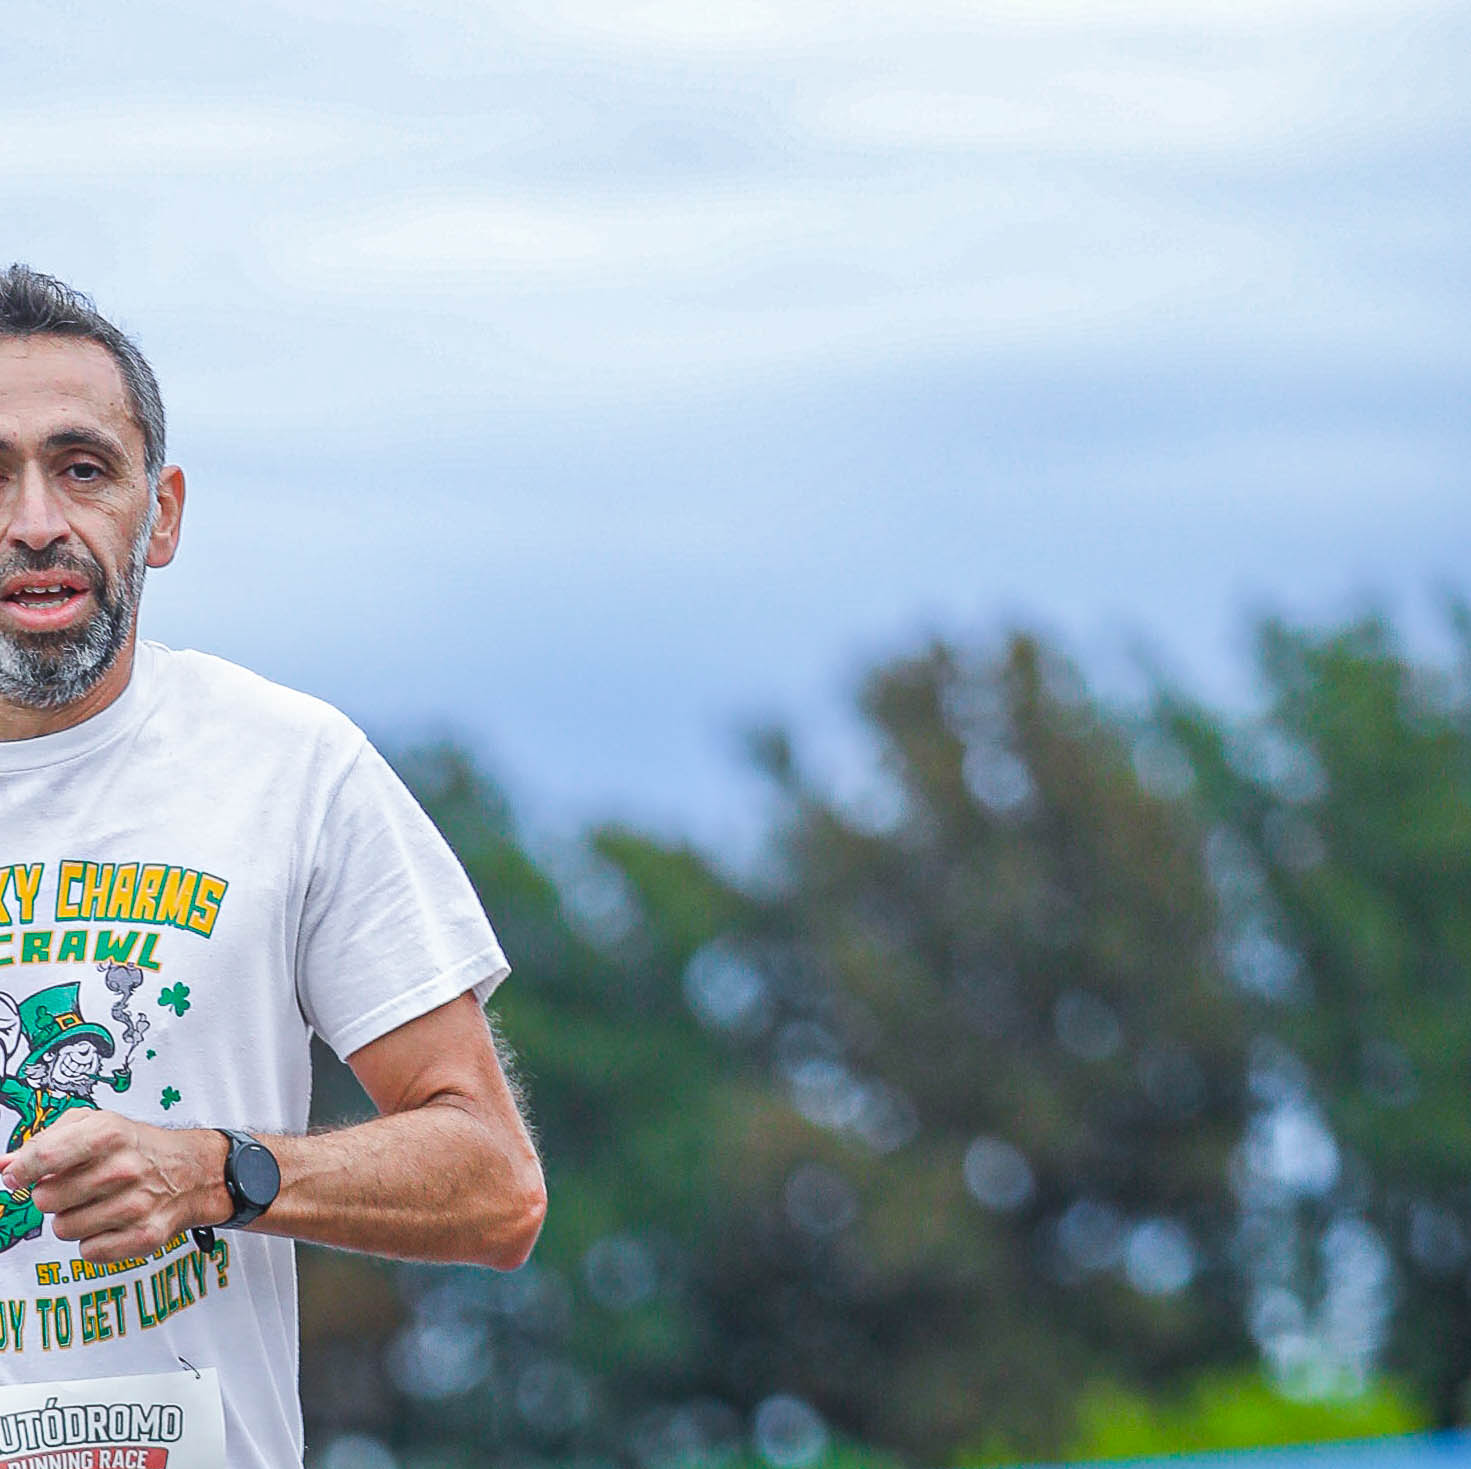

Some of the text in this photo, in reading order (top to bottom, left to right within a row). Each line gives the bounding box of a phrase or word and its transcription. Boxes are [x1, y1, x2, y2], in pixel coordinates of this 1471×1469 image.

[55, 860, 228, 939] CHARMS
[35, 1262, 69, 1285] ST.
[36, 1297, 73, 1351] TO
[79, 1284, 128, 1346] GET
[135, 1238, 229, 1330] LUCKY?
